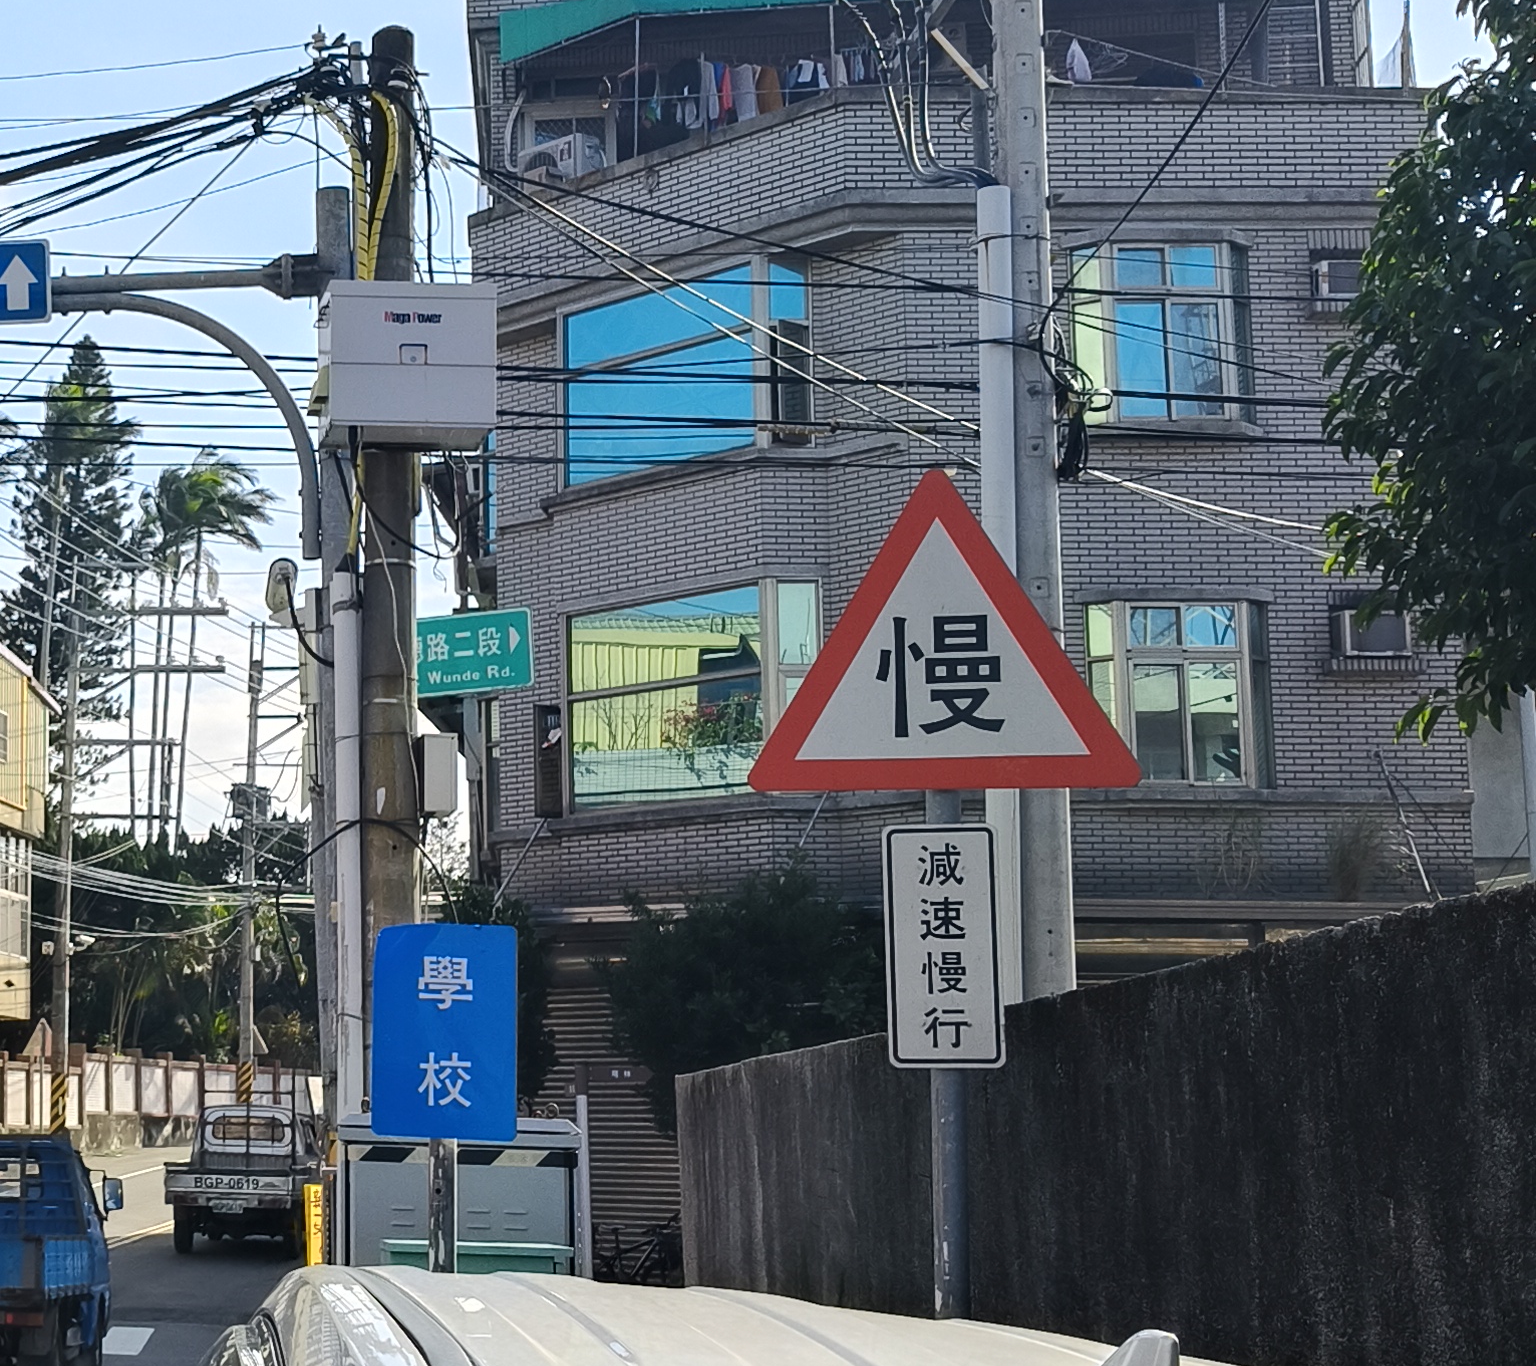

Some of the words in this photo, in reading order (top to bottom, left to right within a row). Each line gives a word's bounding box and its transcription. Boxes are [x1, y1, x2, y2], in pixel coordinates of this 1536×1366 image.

[412, 311, 442, 324] Power
[427, 670, 480, 685] Wunde
[487, 664, 515, 679] Rd.
[875, 614, 1005, 738] 慢
[917, 842, 972, 1049] 減速慢行
[417, 956, 473, 1108] 學校
[194, 1176, 260, 1190] BGP-0619
